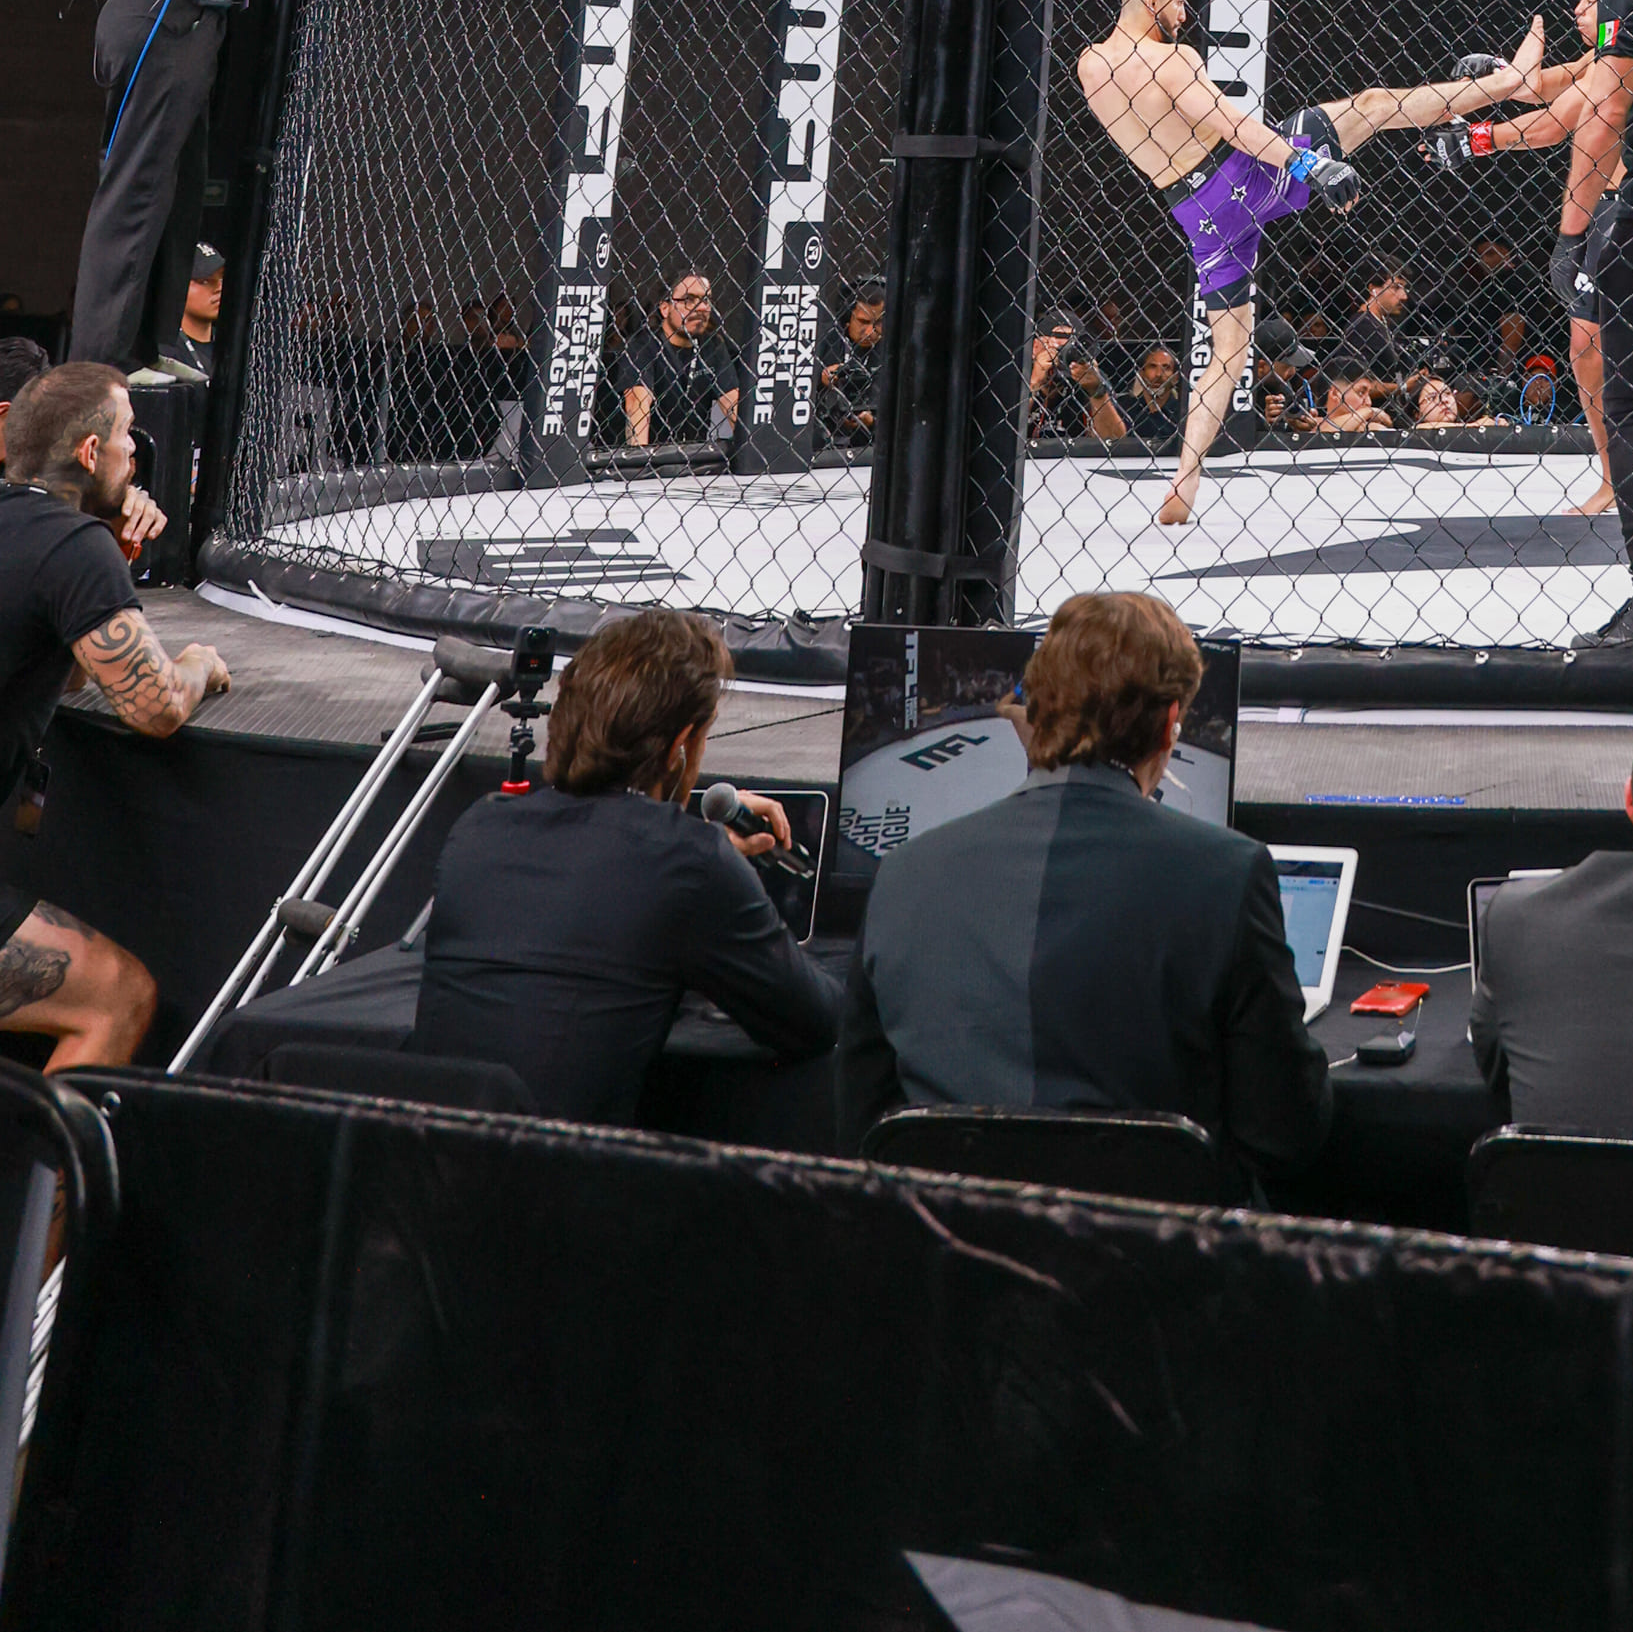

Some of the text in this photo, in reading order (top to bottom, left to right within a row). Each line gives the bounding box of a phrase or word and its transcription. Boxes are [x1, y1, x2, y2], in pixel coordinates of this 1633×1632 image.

[542, 284, 576, 437] LEAGUE
[562, 284, 594, 397] FIGHT
[577, 284, 607, 438] MEXICO
[753, 284, 782, 426] LEAGUE
[775, 284, 800, 385] FIGHT
[791, 284, 820, 427] MEXICO
[899, 733, 991, 772] MFL
